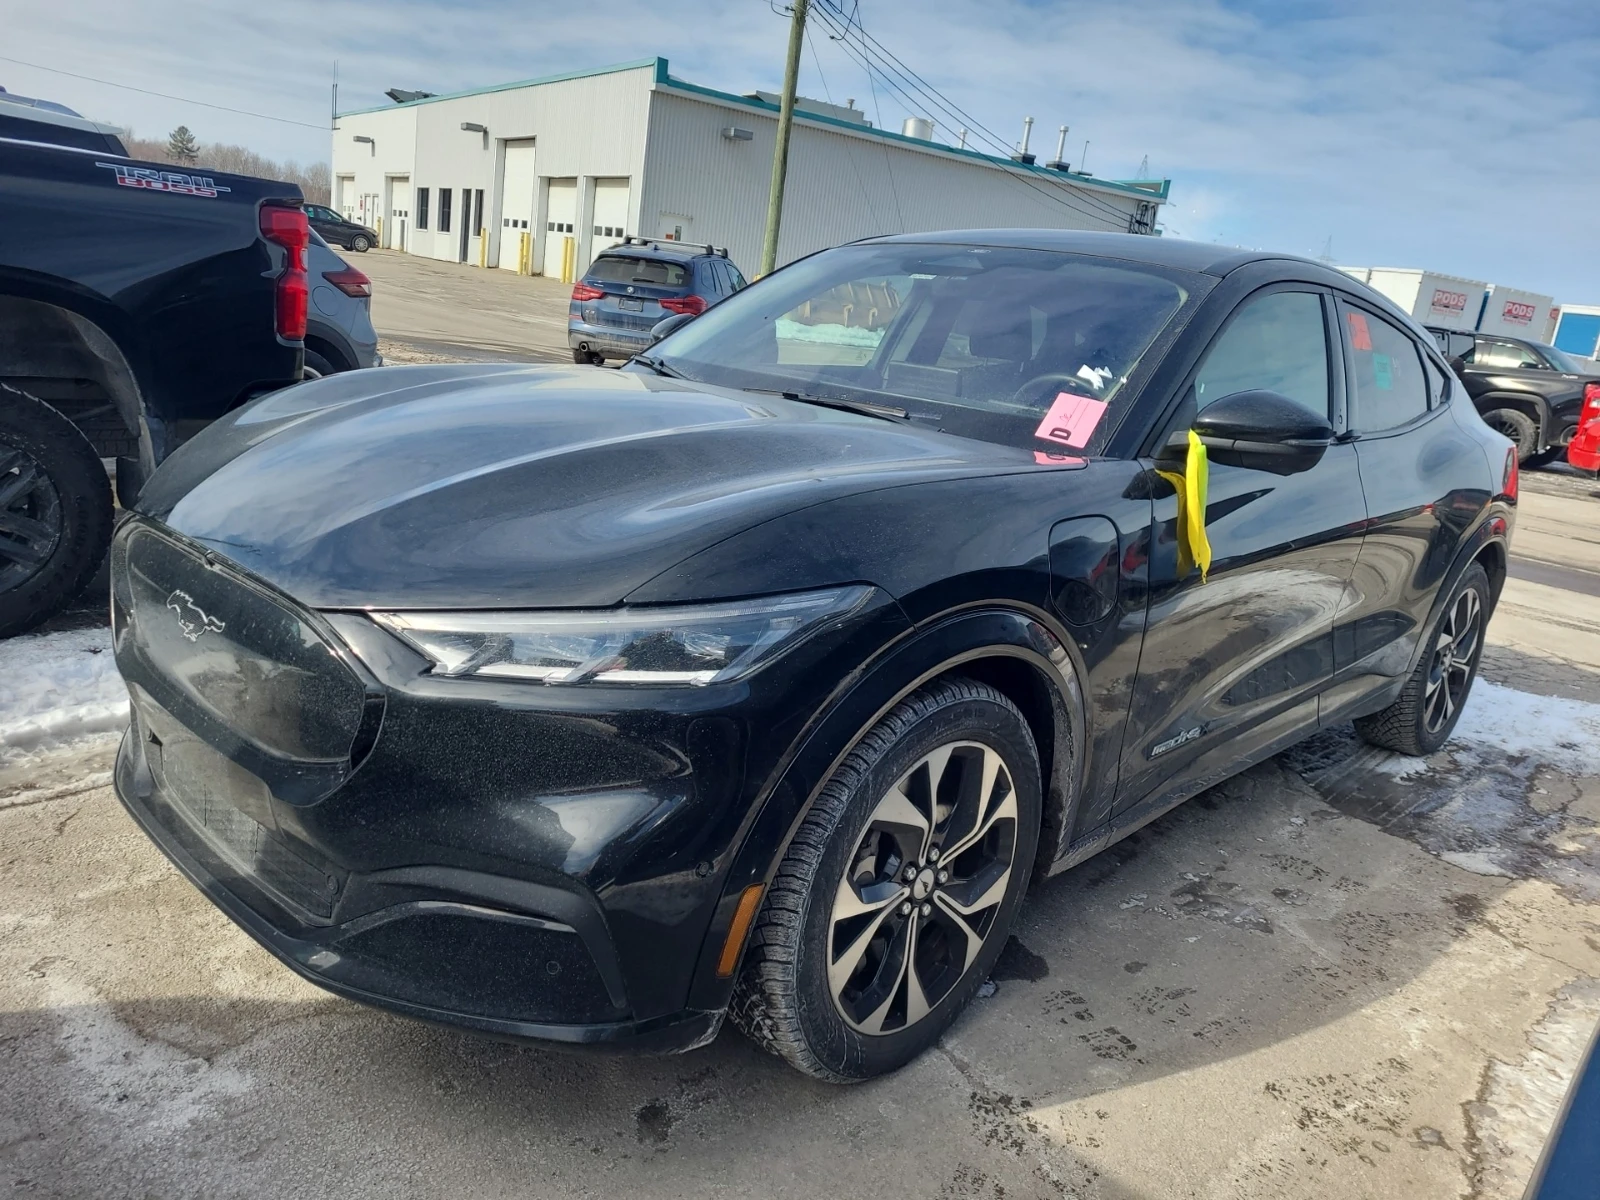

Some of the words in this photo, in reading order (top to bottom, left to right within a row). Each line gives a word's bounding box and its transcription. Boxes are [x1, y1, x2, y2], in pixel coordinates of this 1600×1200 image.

[95, 162, 231, 192] TRAIL
[117, 176, 217, 197] BOSS
[1434, 290, 1467, 307] PODS
[1504, 302, 1535, 318] PODS
[1049, 427, 1072, 441] D
